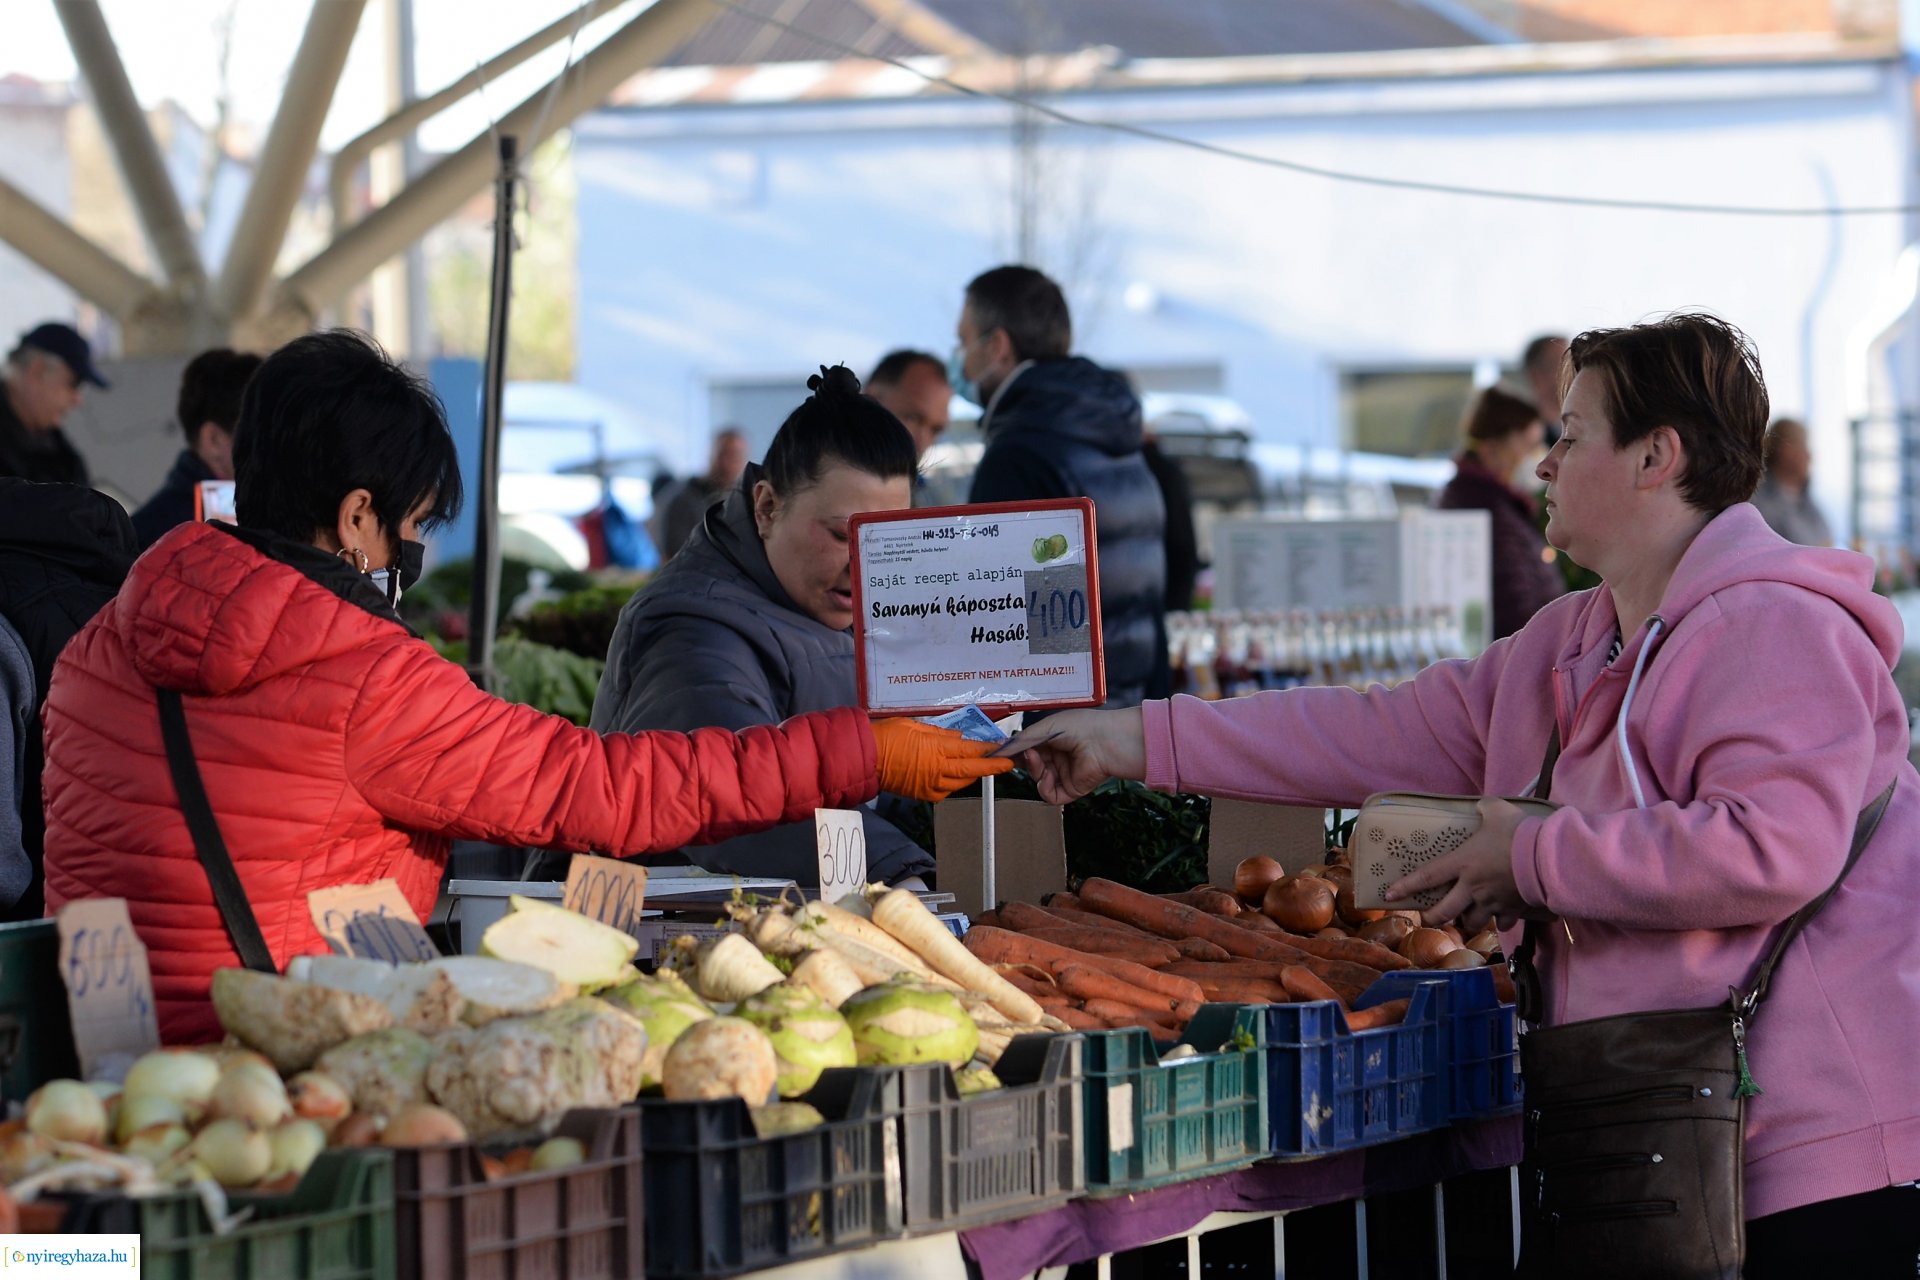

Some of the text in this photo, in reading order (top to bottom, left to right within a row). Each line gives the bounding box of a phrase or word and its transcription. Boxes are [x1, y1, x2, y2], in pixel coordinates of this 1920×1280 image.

[869, 566, 1023, 589] Saját recept alapján
[871, 596, 941, 619] Savanyú
[1029, 588, 1086, 638] 400
[887, 666, 1075, 685] TARTÓSÍTÓSZERT NEM TARTALMAZ!!!
